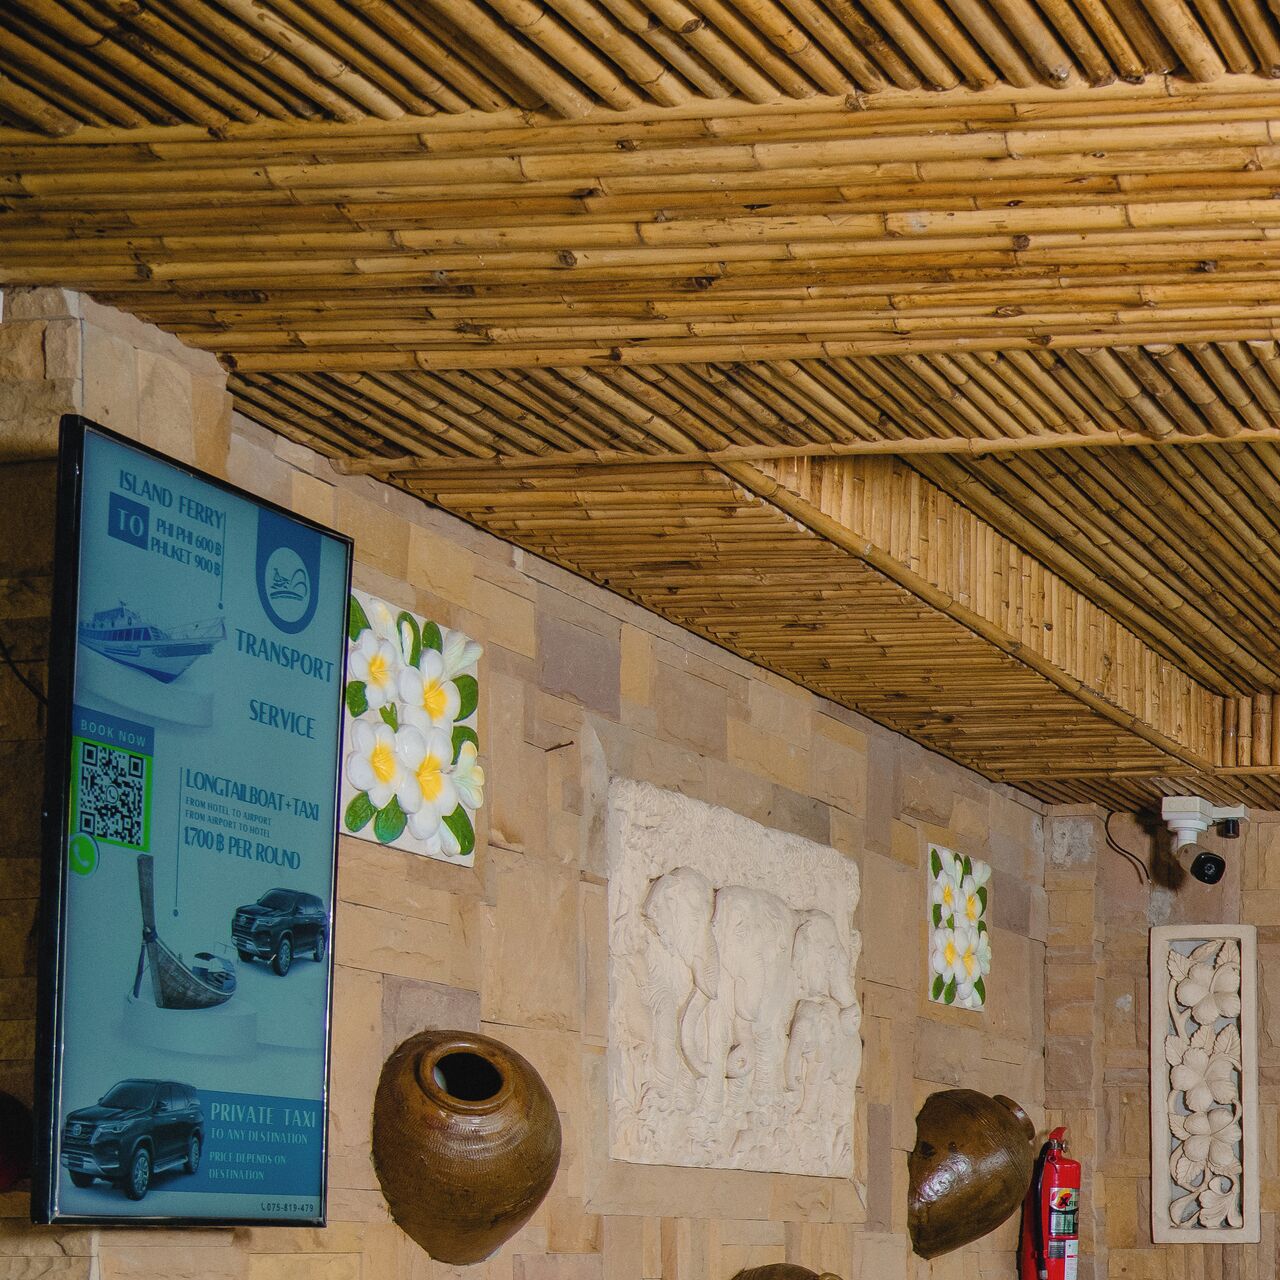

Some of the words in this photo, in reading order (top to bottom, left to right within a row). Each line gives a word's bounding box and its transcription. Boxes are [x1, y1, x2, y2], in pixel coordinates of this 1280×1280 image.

[120, 470, 173, 508] ISLAND
[179, 495, 223, 529] FERRY
[117, 508, 144, 537] TO
[157, 518, 174, 537] PHI
[176, 526, 193, 545] PHI
[195, 535, 213, 553] 600
[151, 537, 192, 565] PHUKET
[195, 555, 213, 573] 900
[235, 628, 334, 683] TRANSPORT
[81, 720, 114, 738] BOOK
[119, 730, 146, 747] NOW
[249, 699, 317, 739] SERVICE
[185, 797, 206, 809] FROM
[207, 800, 230, 816] HOTEL
[232, 808, 241, 818] TO
[243, 811, 273, 826] AIRPORT
[185, 810, 206, 822] FROM
[207, 814, 237, 829] AIRPORT
[239, 822, 248, 832] TO
[250, 825, 270, 838] HOTEL
[228, 836, 253, 860] PER
[255, 843, 301, 870] ROUND
[211, 1102, 275, 1125] PRIVATE
[281, 1108, 315, 1128] TAXI
[211, 1127, 224, 1139] TO
[227, 1129, 245, 1141] ANY
[248, 1130, 308, 1144] DESTINATION
[209, 1151, 233, 1162] PRICE
[236, 1152, 272, 1164] DEPENDS
[274, 1155, 287, 1164] ON
[209, 1168, 265, 1180] DESTINATION
